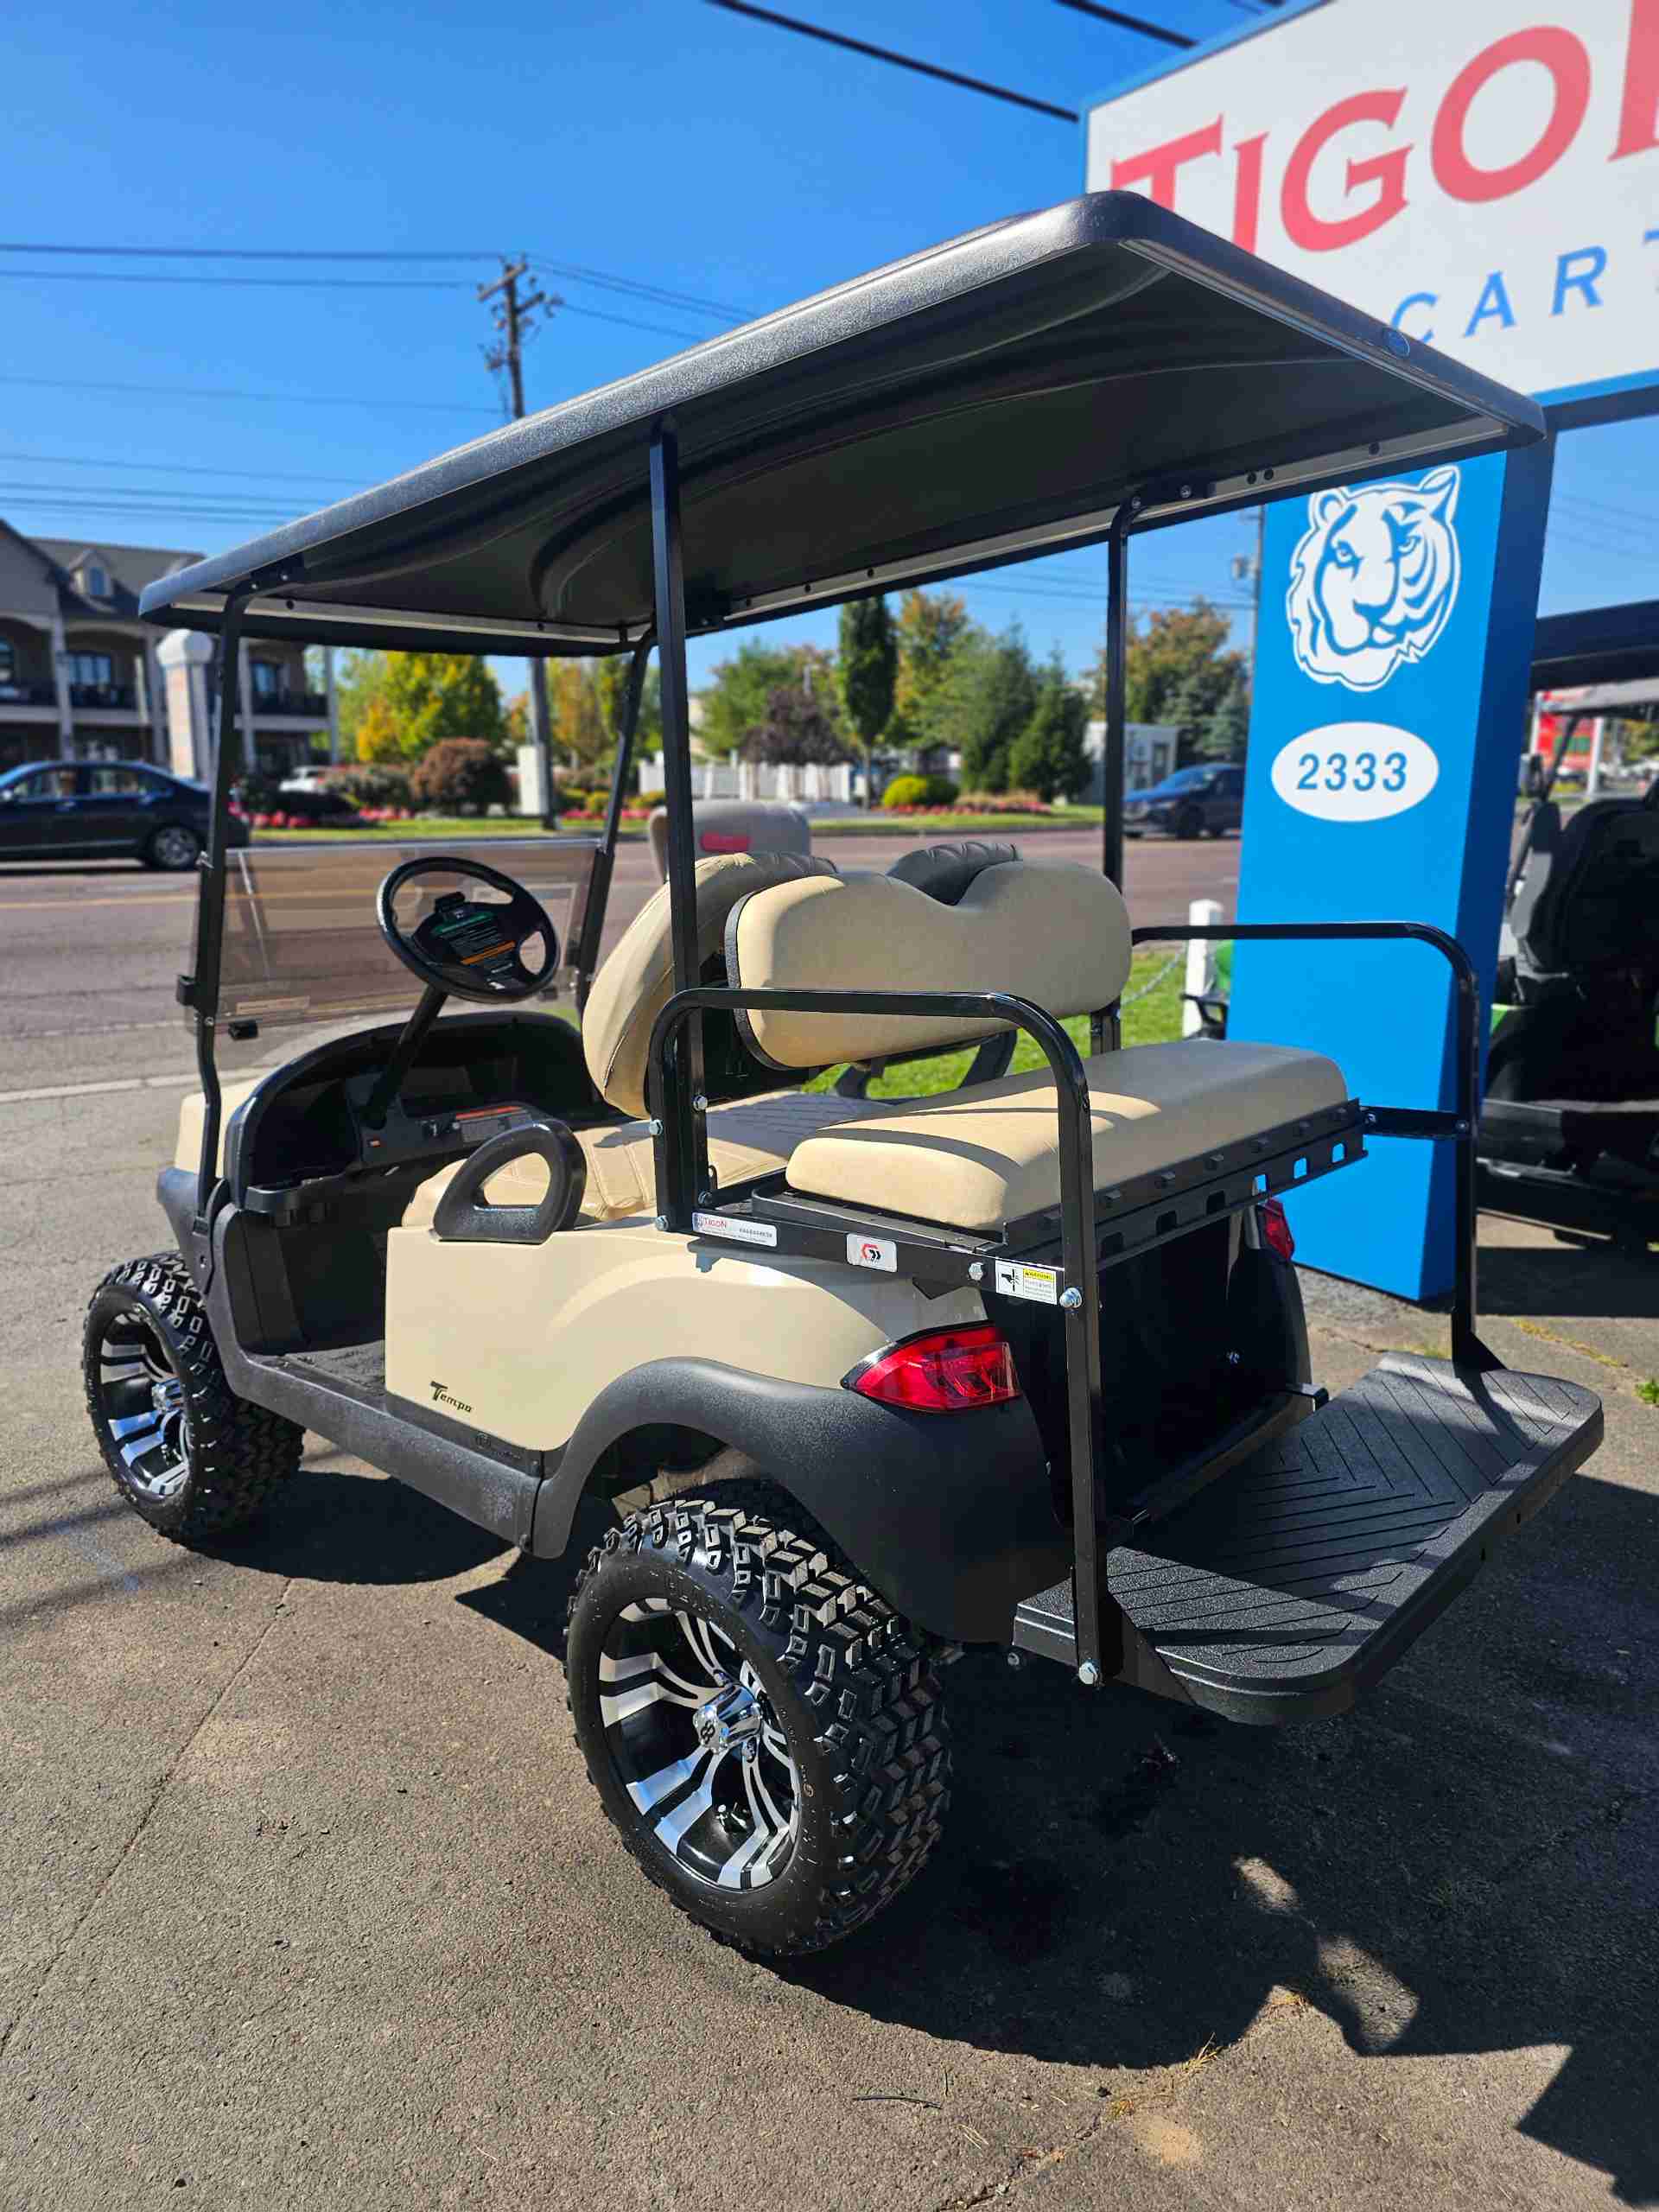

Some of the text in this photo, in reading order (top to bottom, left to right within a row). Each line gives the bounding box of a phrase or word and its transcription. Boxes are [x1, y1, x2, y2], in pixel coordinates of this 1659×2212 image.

[1390, 230, 1659, 345] CAR
[1296, 752, 1408, 791] 2333
[430, 1381, 472, 1413] Tempo
